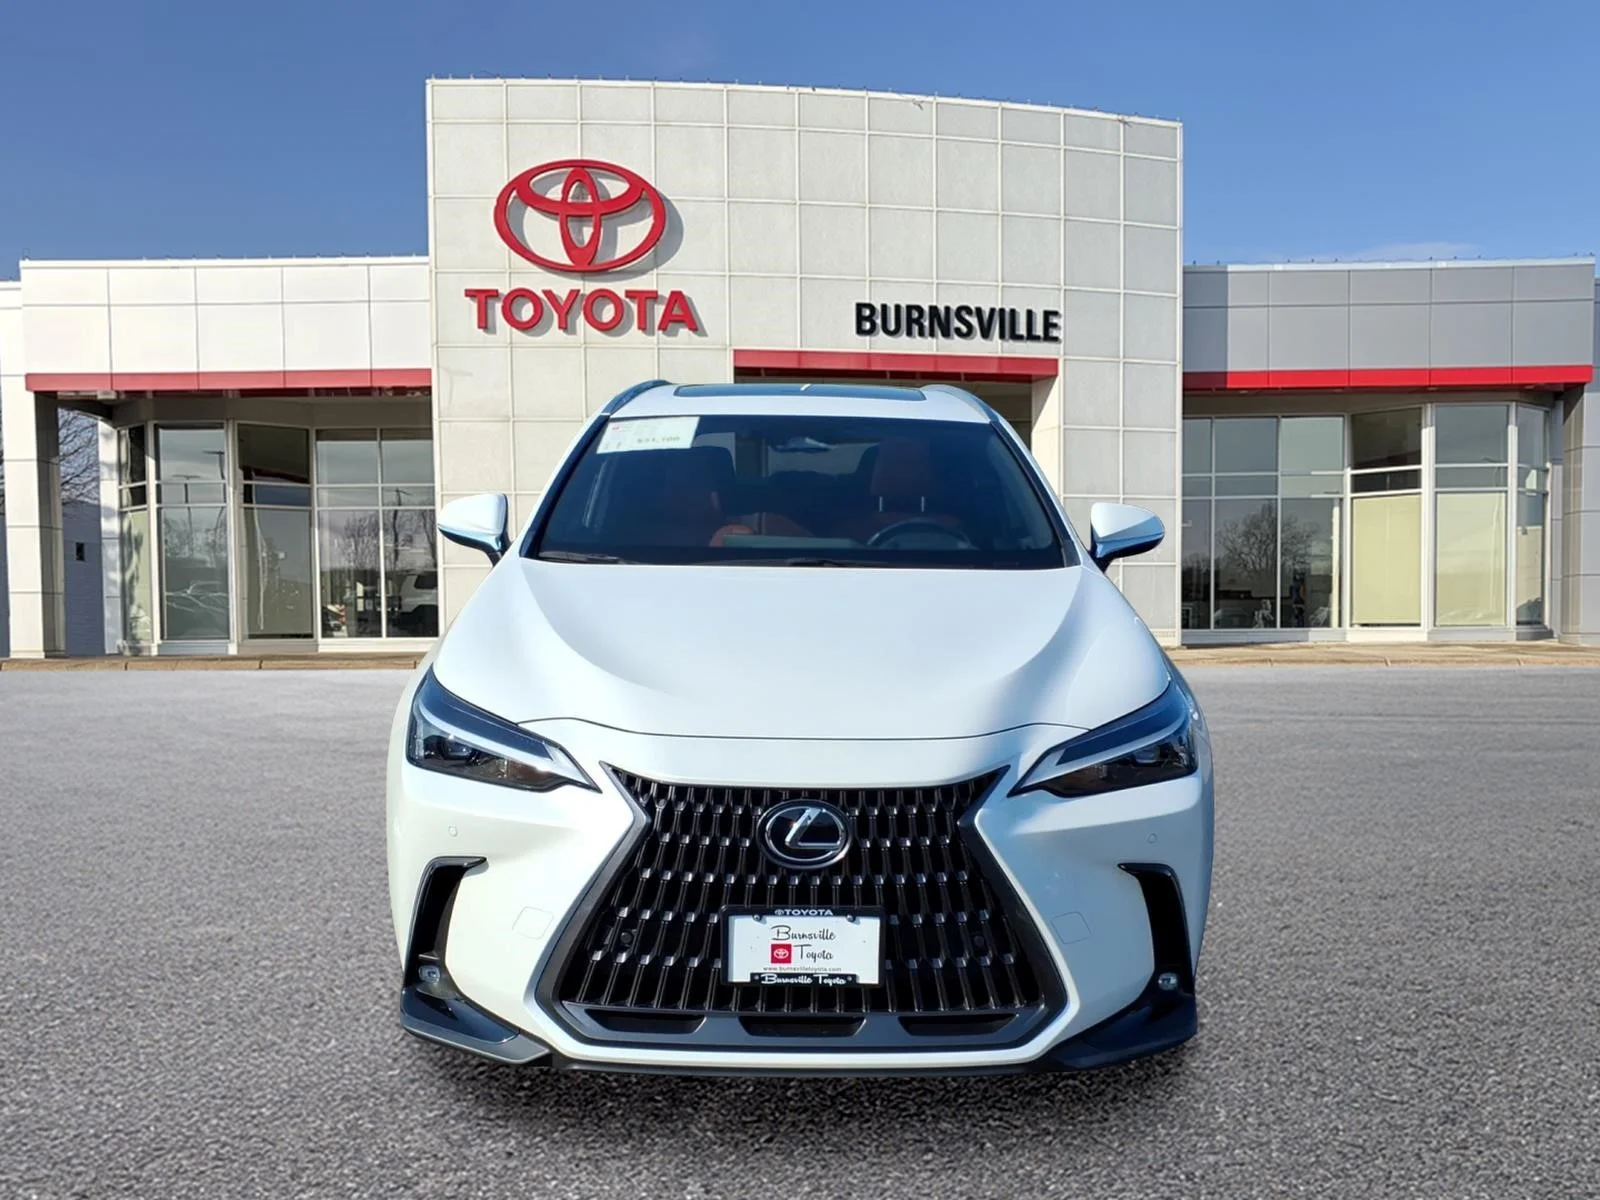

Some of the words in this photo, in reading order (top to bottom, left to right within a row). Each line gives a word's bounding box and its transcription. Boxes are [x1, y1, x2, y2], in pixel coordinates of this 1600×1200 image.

[464, 287, 699, 332] TOYOTA
[855, 302, 1062, 343] BURNSVILLE
[784, 908, 833, 916] TOYOTA
[770, 924, 837, 941] Burnsville
[794, 943, 834, 963] Toyota
[760, 973, 813, 984] Burnsville
[813, 973, 847, 986] Toyota
